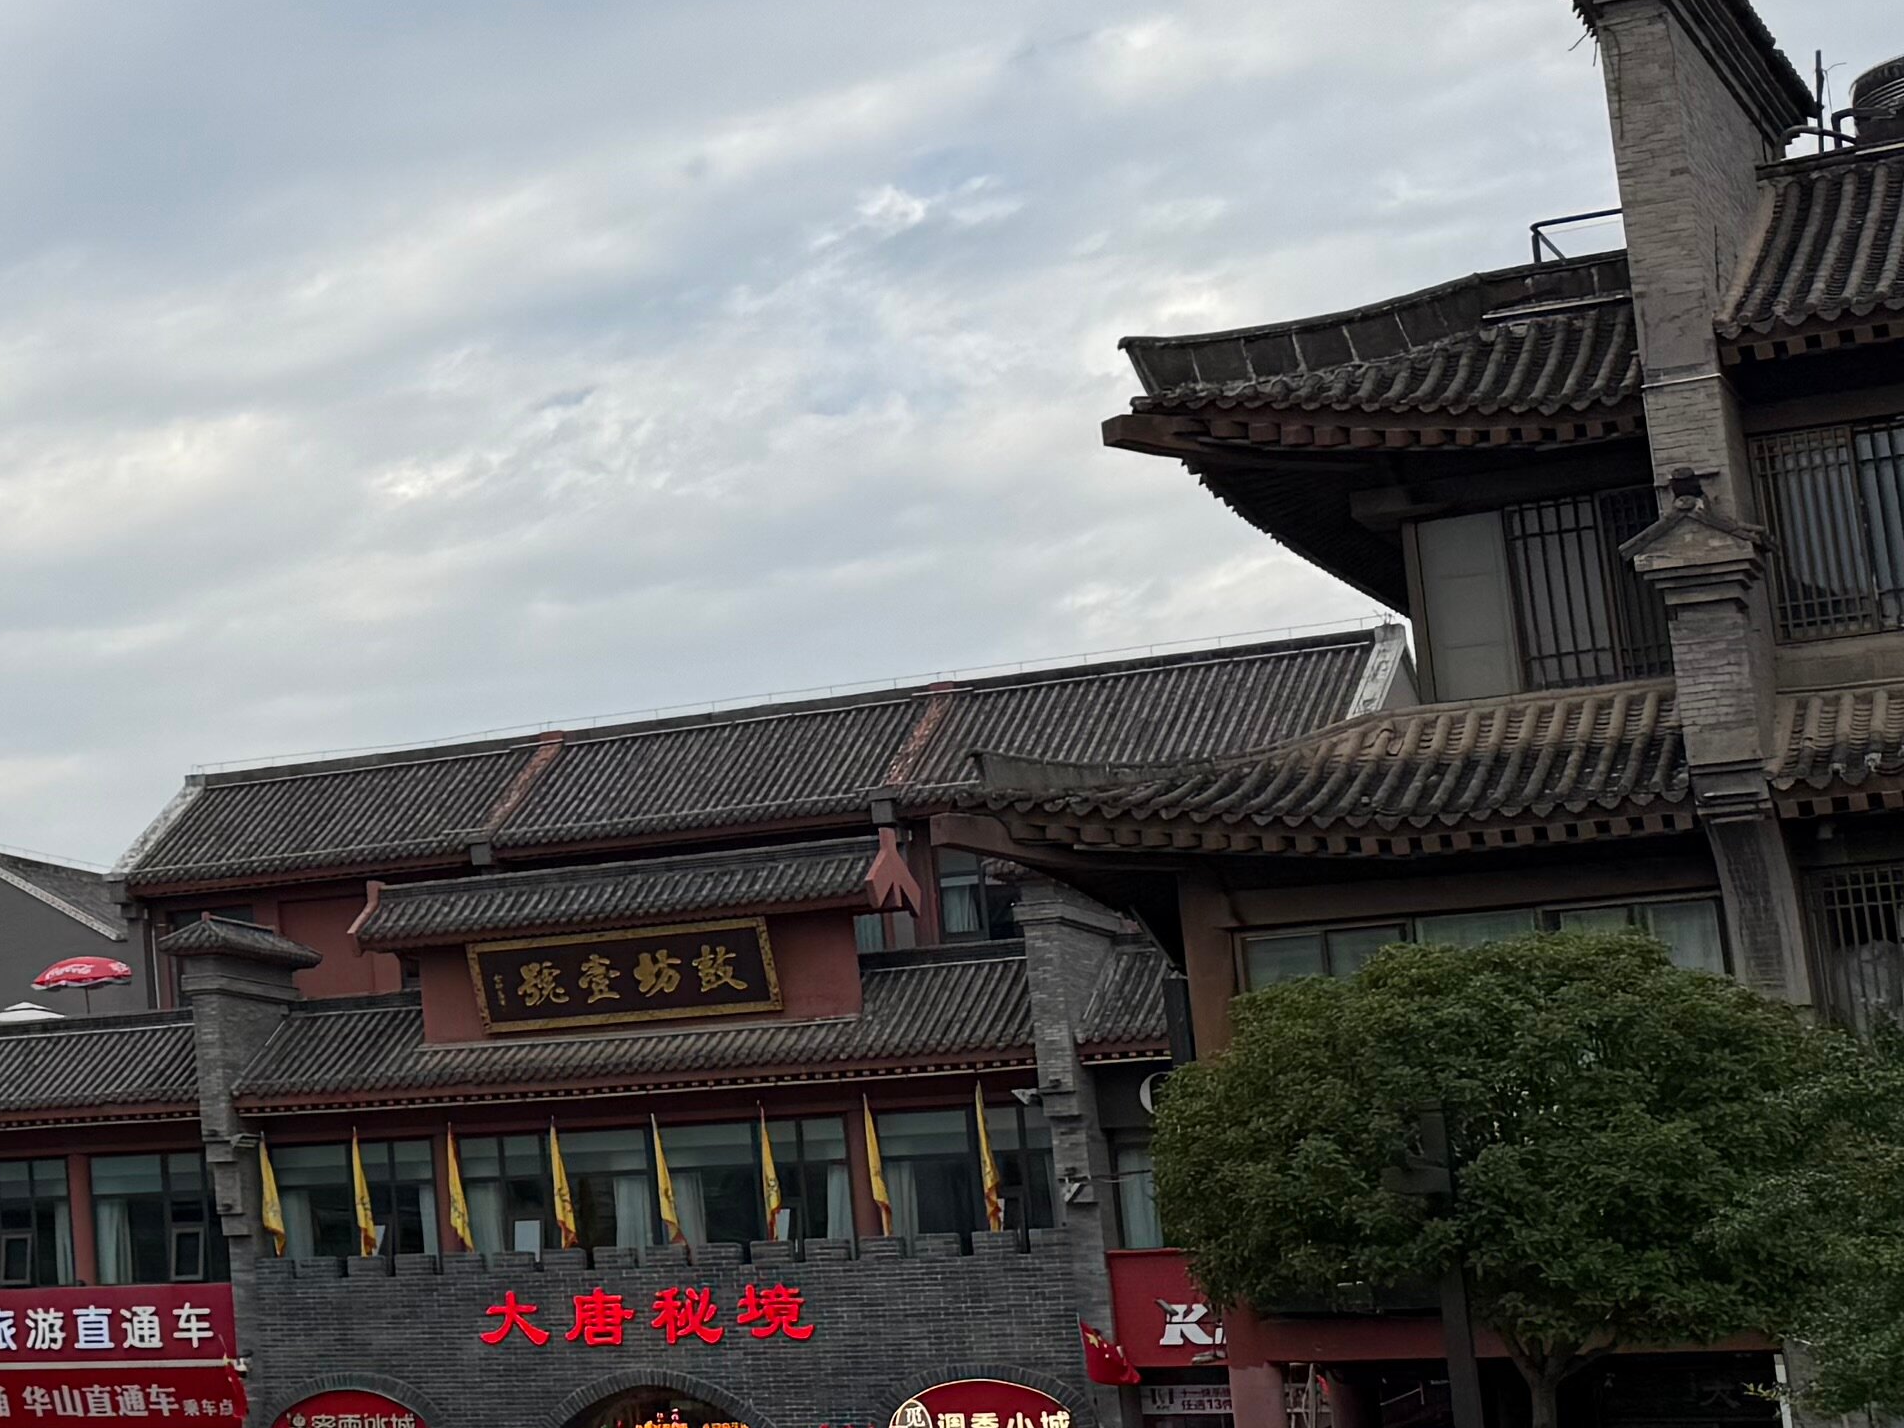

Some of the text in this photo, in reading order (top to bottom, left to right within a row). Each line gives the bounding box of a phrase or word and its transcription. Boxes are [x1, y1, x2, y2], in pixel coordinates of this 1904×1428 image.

[480, 1283, 815, 1346] 大唐秘境
[22, 1384, 180, 1418] 华山直通车
